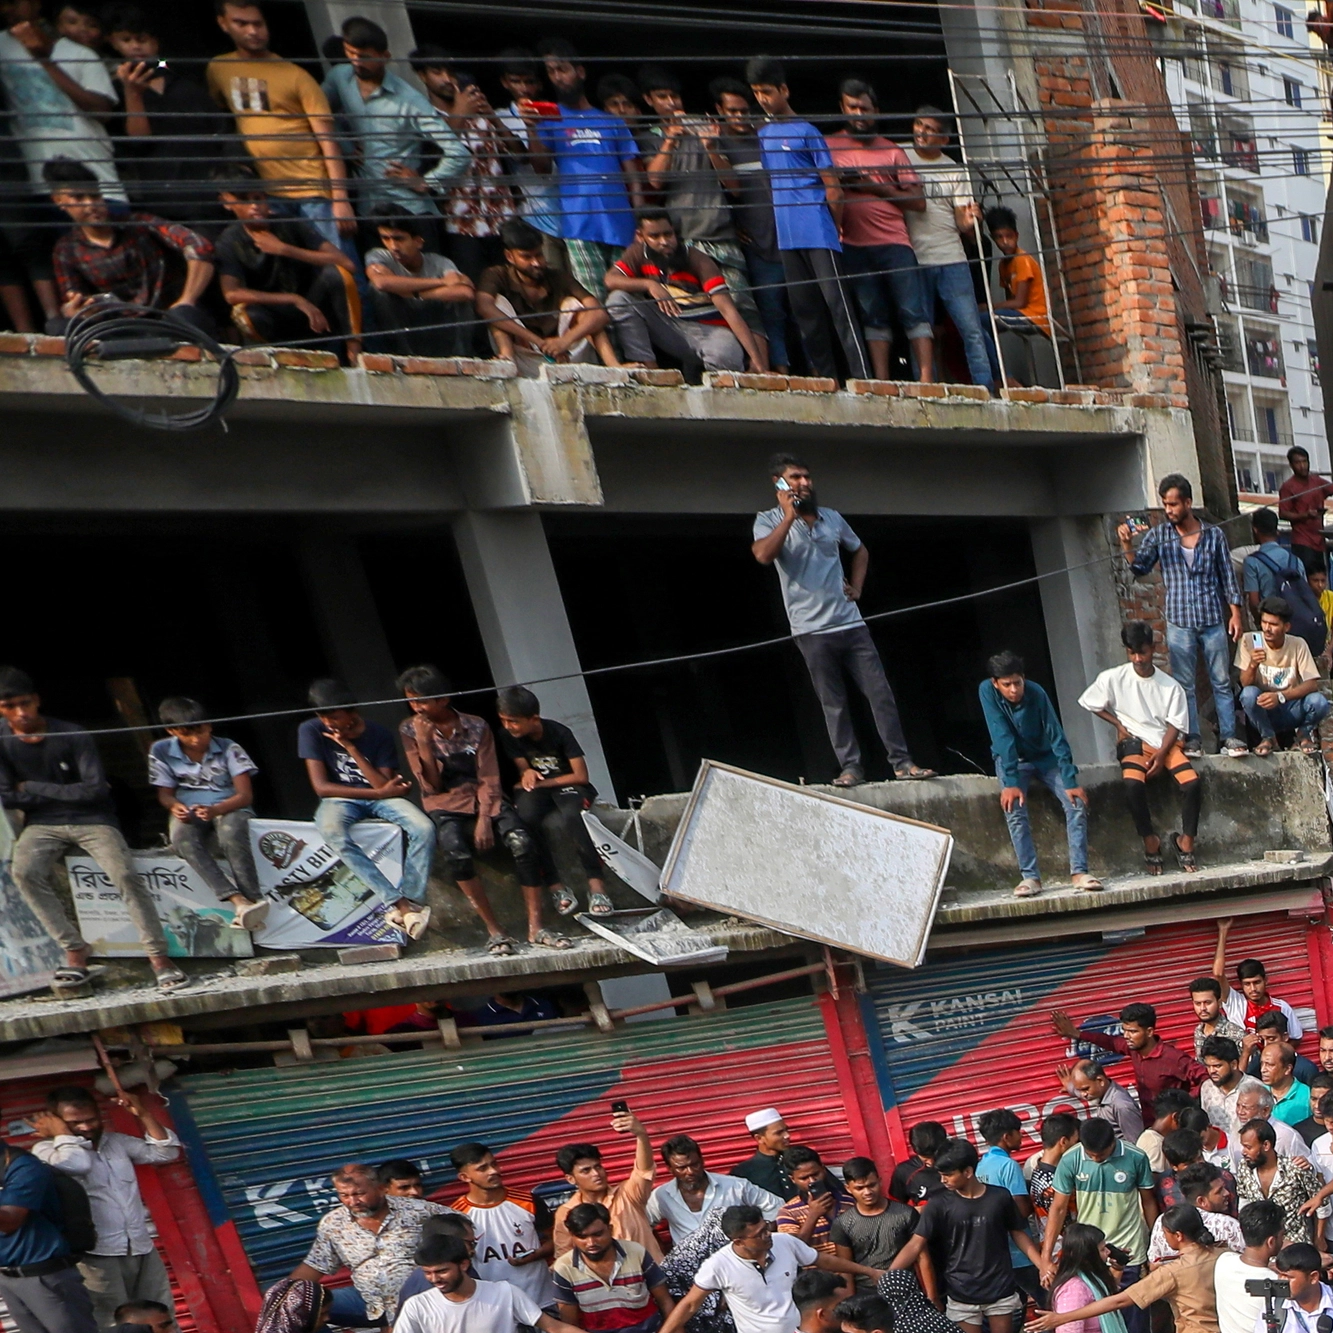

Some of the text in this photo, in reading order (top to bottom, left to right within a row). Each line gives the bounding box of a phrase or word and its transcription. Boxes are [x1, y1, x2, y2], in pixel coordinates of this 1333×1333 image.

[930, 989, 1023, 1019] KANSAI
[934, 1012, 986, 1033] PAINT
[483, 1241, 527, 1263] AIA
